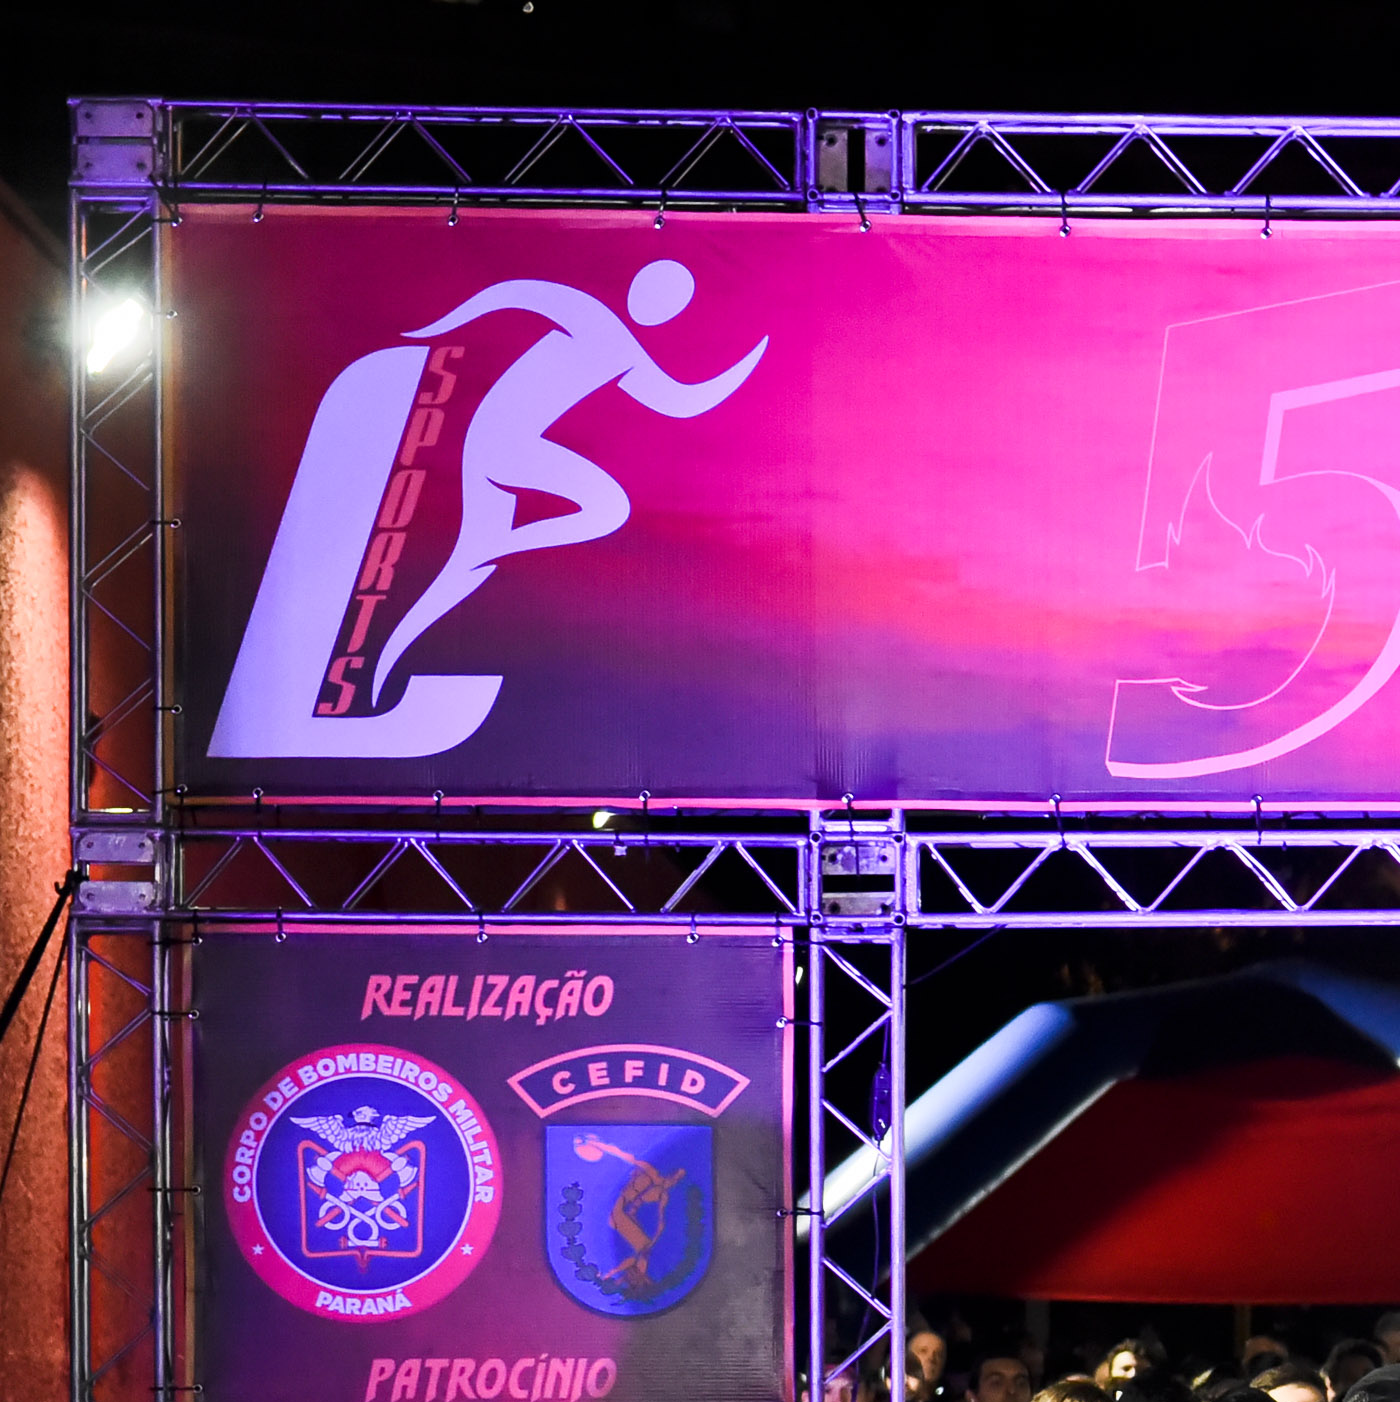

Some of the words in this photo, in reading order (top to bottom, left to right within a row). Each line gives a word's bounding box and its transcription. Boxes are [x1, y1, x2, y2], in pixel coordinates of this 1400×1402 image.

[316, 345, 465, 717] SPORTS
[361, 970, 614, 1025] REALIZAÇÃO
[553, 1061, 706, 1095] CEFID
[233, 1112, 267, 1203] CORPO
[263, 1077, 299, 1111] DE
[297, 1053, 453, 1104] BOMBEIROS
[449, 1099, 494, 1204] MILITAR
[315, 1289, 413, 1315] PARANÁ
